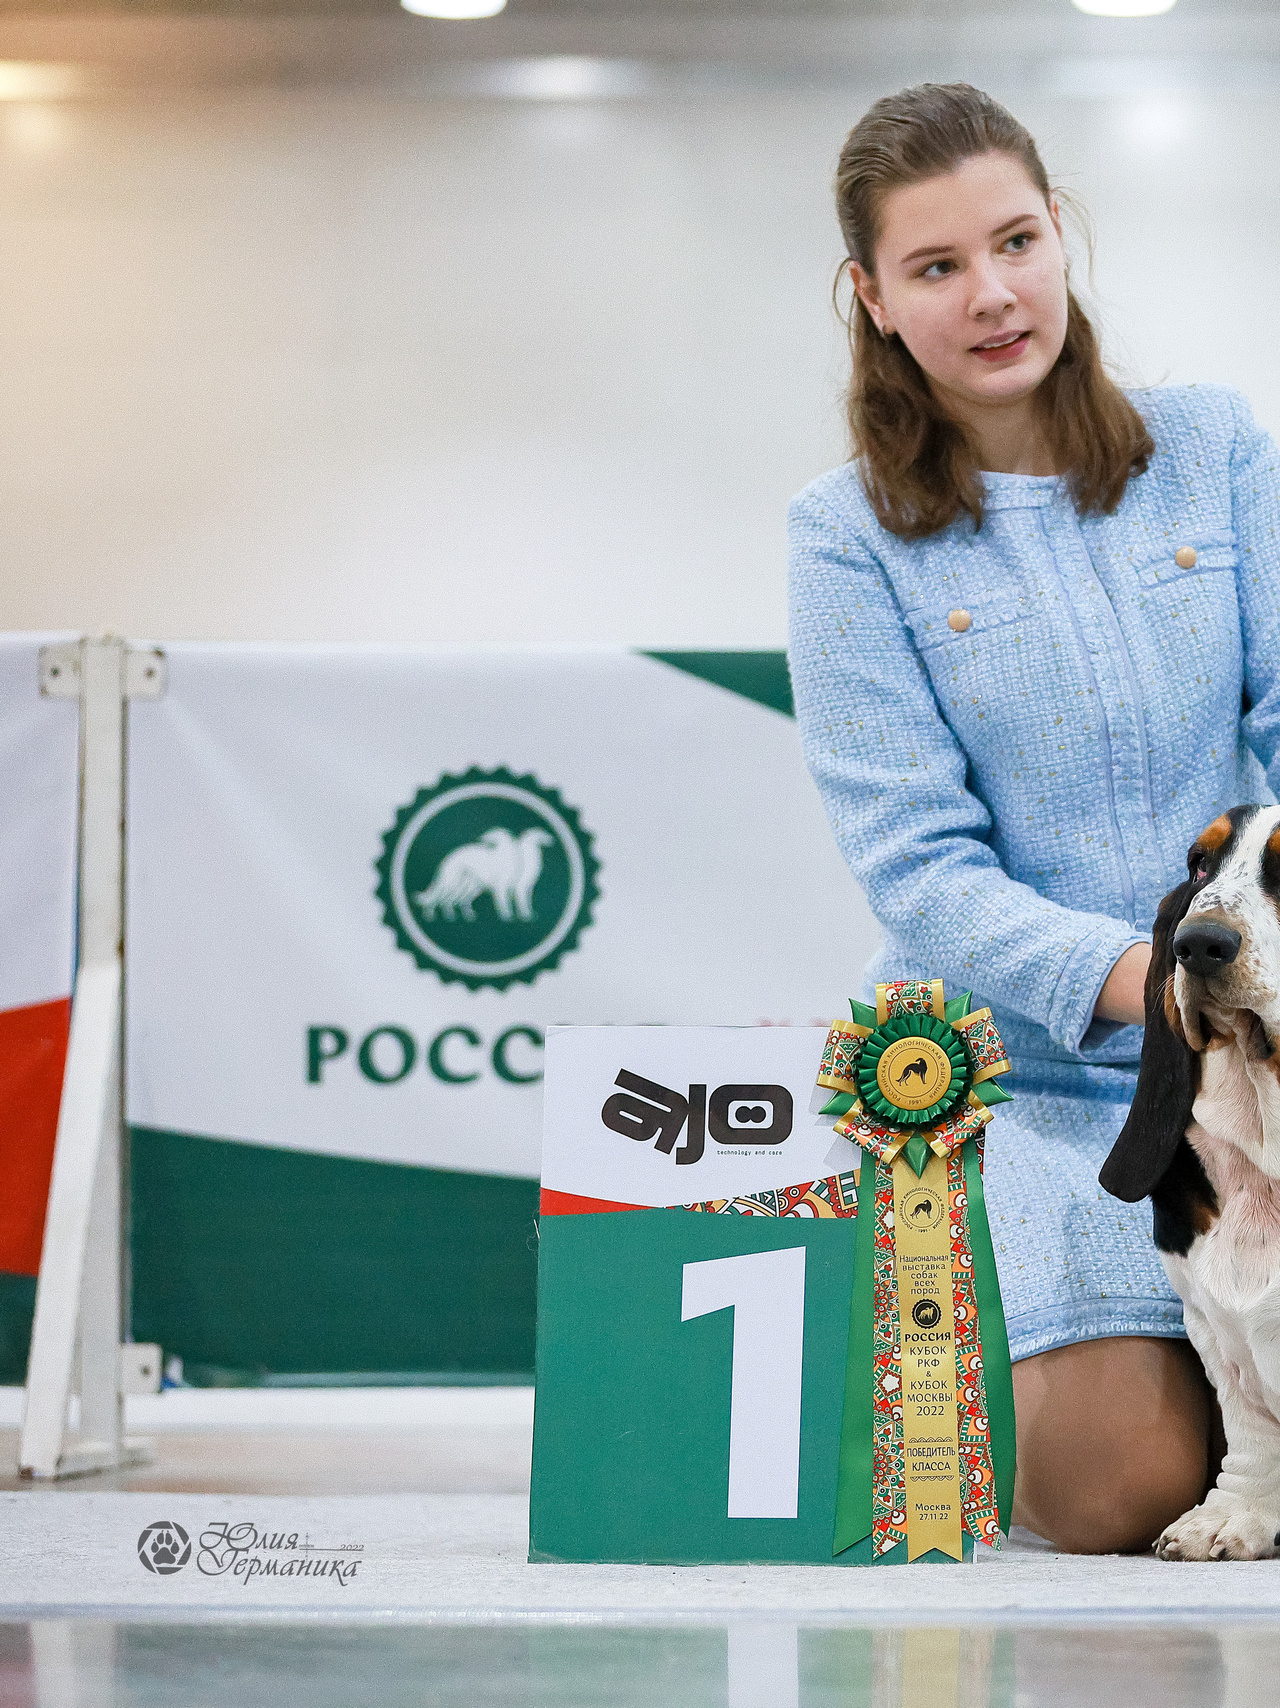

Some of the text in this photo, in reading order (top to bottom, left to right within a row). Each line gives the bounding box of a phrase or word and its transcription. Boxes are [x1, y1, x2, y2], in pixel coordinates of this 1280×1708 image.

[304, 1023, 545, 1086] РОСС
[899, 1254, 949, 1263] Национальная
[902, 1263, 946, 1271] выставка
[910, 1271, 938, 1279] собак
[910, 1287, 940, 1296] пород
[904, 1332, 951, 1342] РОССИЯ
[909, 1346, 947, 1355] КУБОК
[917, 1357, 940, 1368] РКФ
[681, 1246, 807, 1519] 1
[910, 1380, 948, 1390] КУБОК
[907, 1393, 953, 1403] МОСКВЫ
[916, 1405, 945, 1416] 2022
[906, 1446, 956, 1457] ПОБЕДИТЕЛЬ
[912, 1461, 951, 1471] КЛАССА
[915, 1502, 951, 1511] Москва
